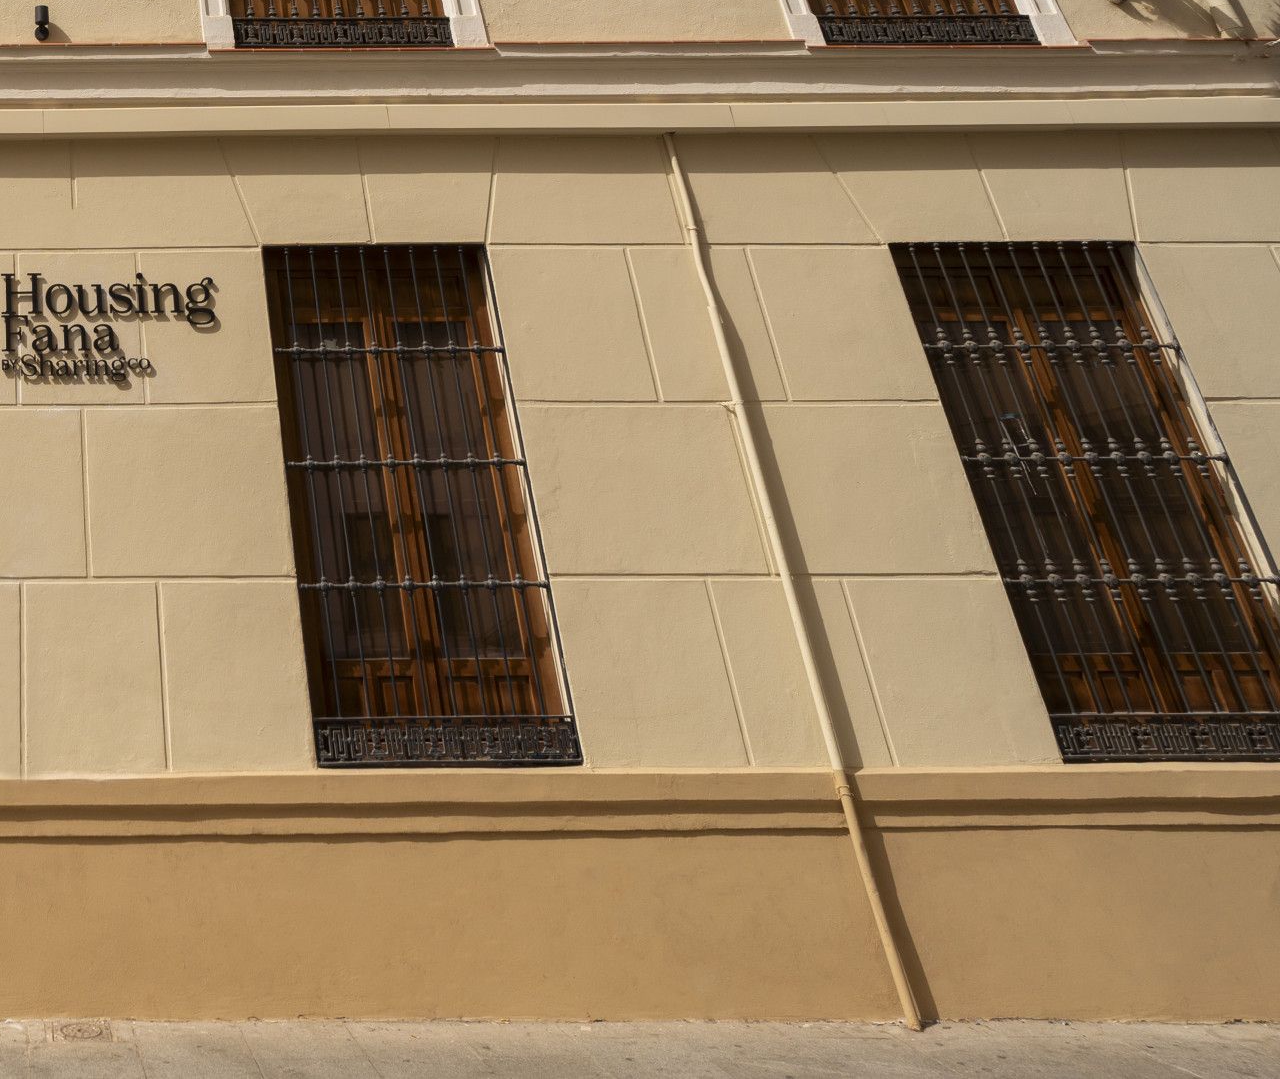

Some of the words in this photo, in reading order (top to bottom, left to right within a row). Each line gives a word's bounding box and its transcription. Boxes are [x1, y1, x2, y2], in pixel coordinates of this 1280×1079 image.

[1, 272, 215, 326] Housing
[1, 315, 119, 353] Fana
[1, 359, 18, 371] BY
